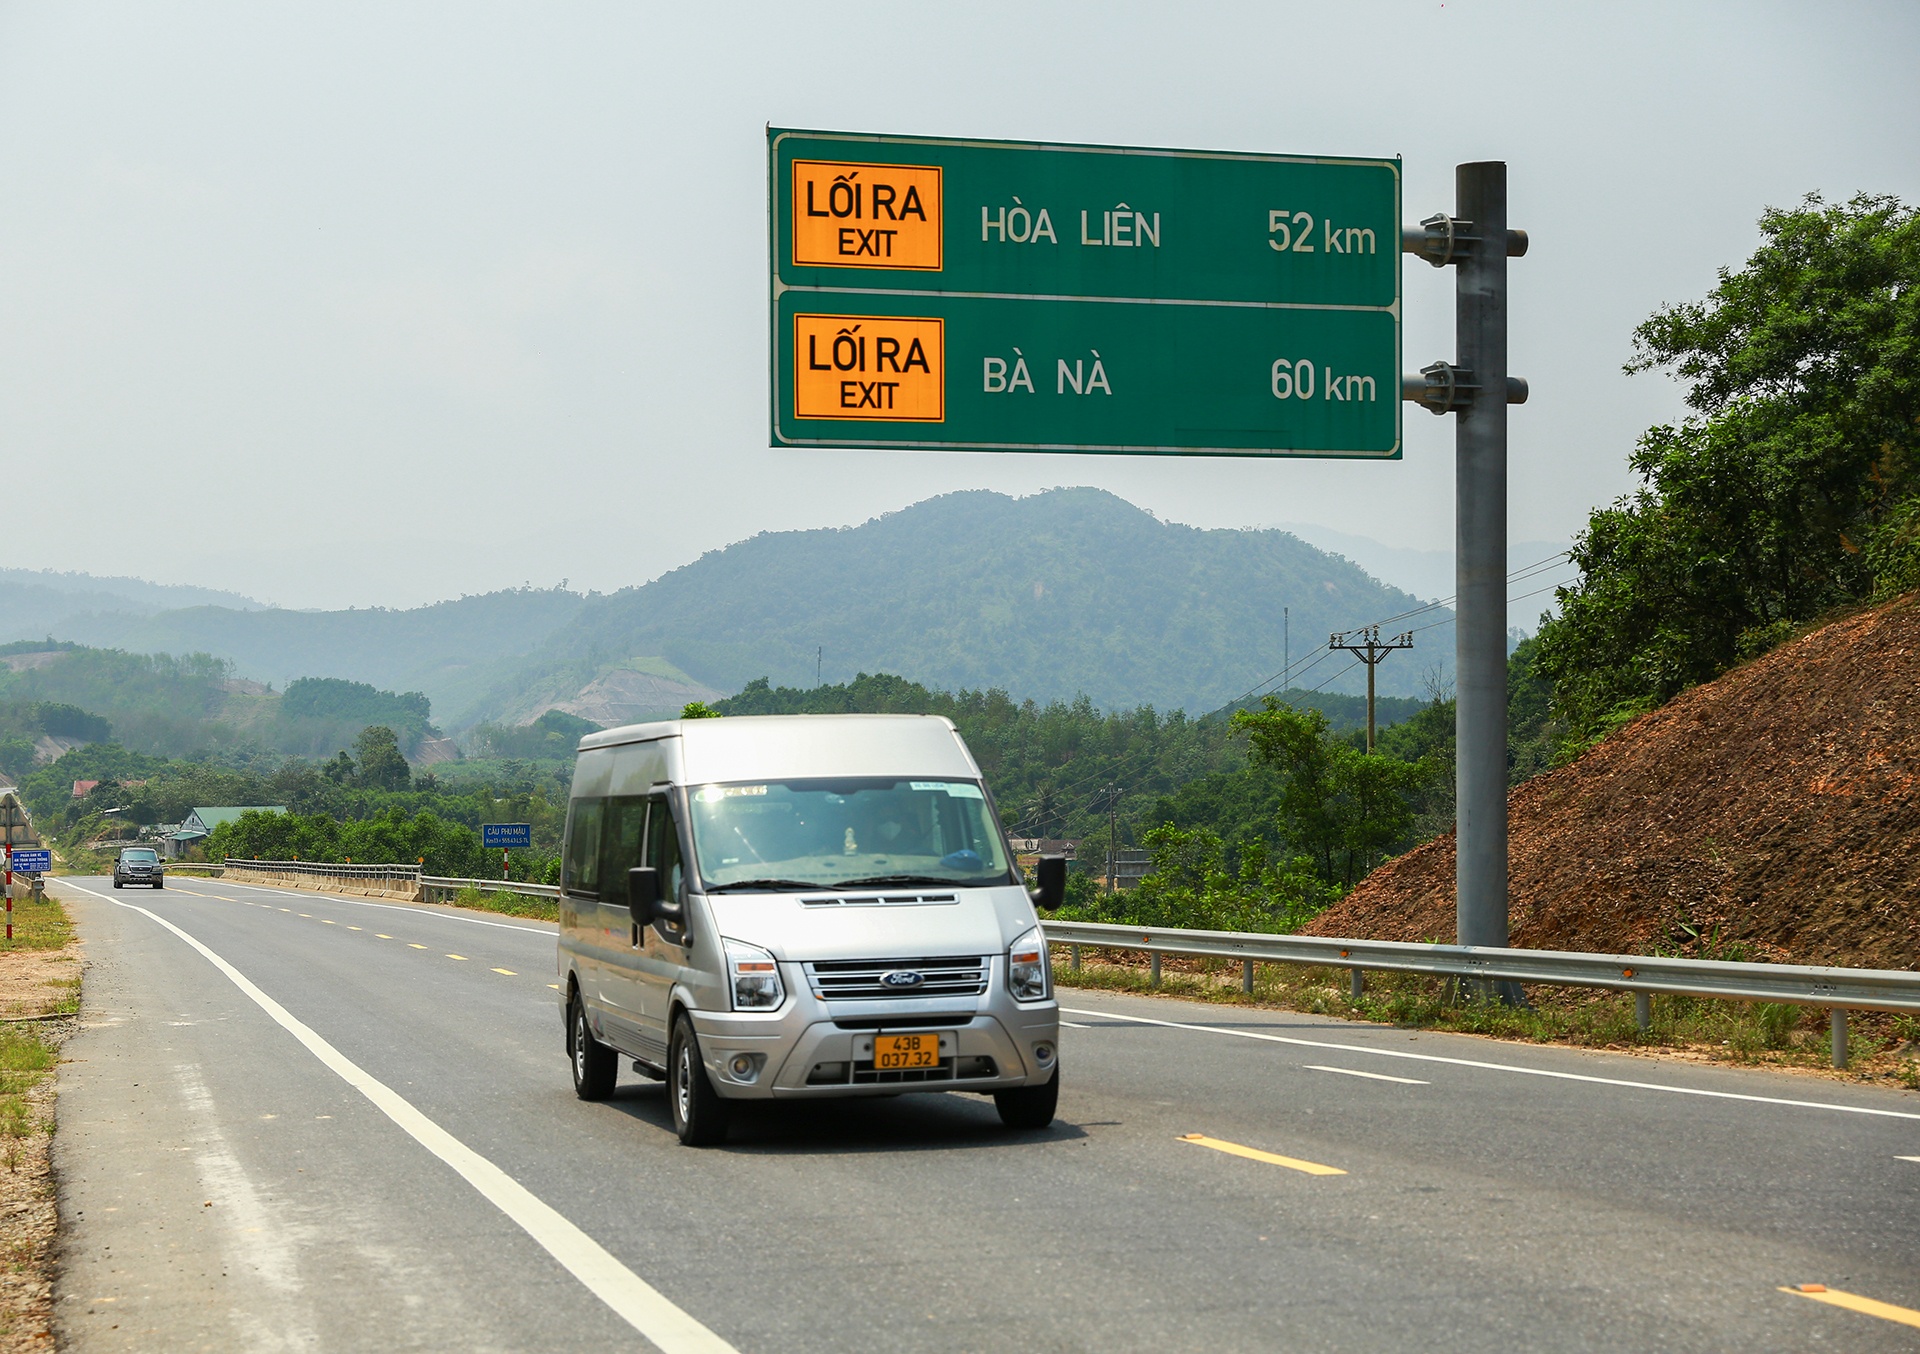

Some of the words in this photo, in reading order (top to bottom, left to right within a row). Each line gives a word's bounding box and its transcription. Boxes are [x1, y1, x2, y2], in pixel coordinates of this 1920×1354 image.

[807, 172, 862, 219] LỐI
[873, 184, 927, 222] RA
[981, 196, 1058, 244] HÒA
[1081, 202, 1160, 247] LIÊN
[1268, 210, 1315, 252] 52
[1325, 219, 1376, 254] km
[838, 228, 898, 257] EXIT
[809, 324, 865, 372] LỐI
[877, 337, 931, 374] RA
[983, 347, 1035, 393] BÀ
[1057, 349, 1112, 395] NÀ
[1271, 358, 1315, 400] 60
[1325, 367, 1376, 402] km
[840, 381, 900, 409] EXIT
[890, 973, 916, 984] Ford
[893, 1036, 921, 1050] 43B
[881, 1052, 932, 1067] 037.32
